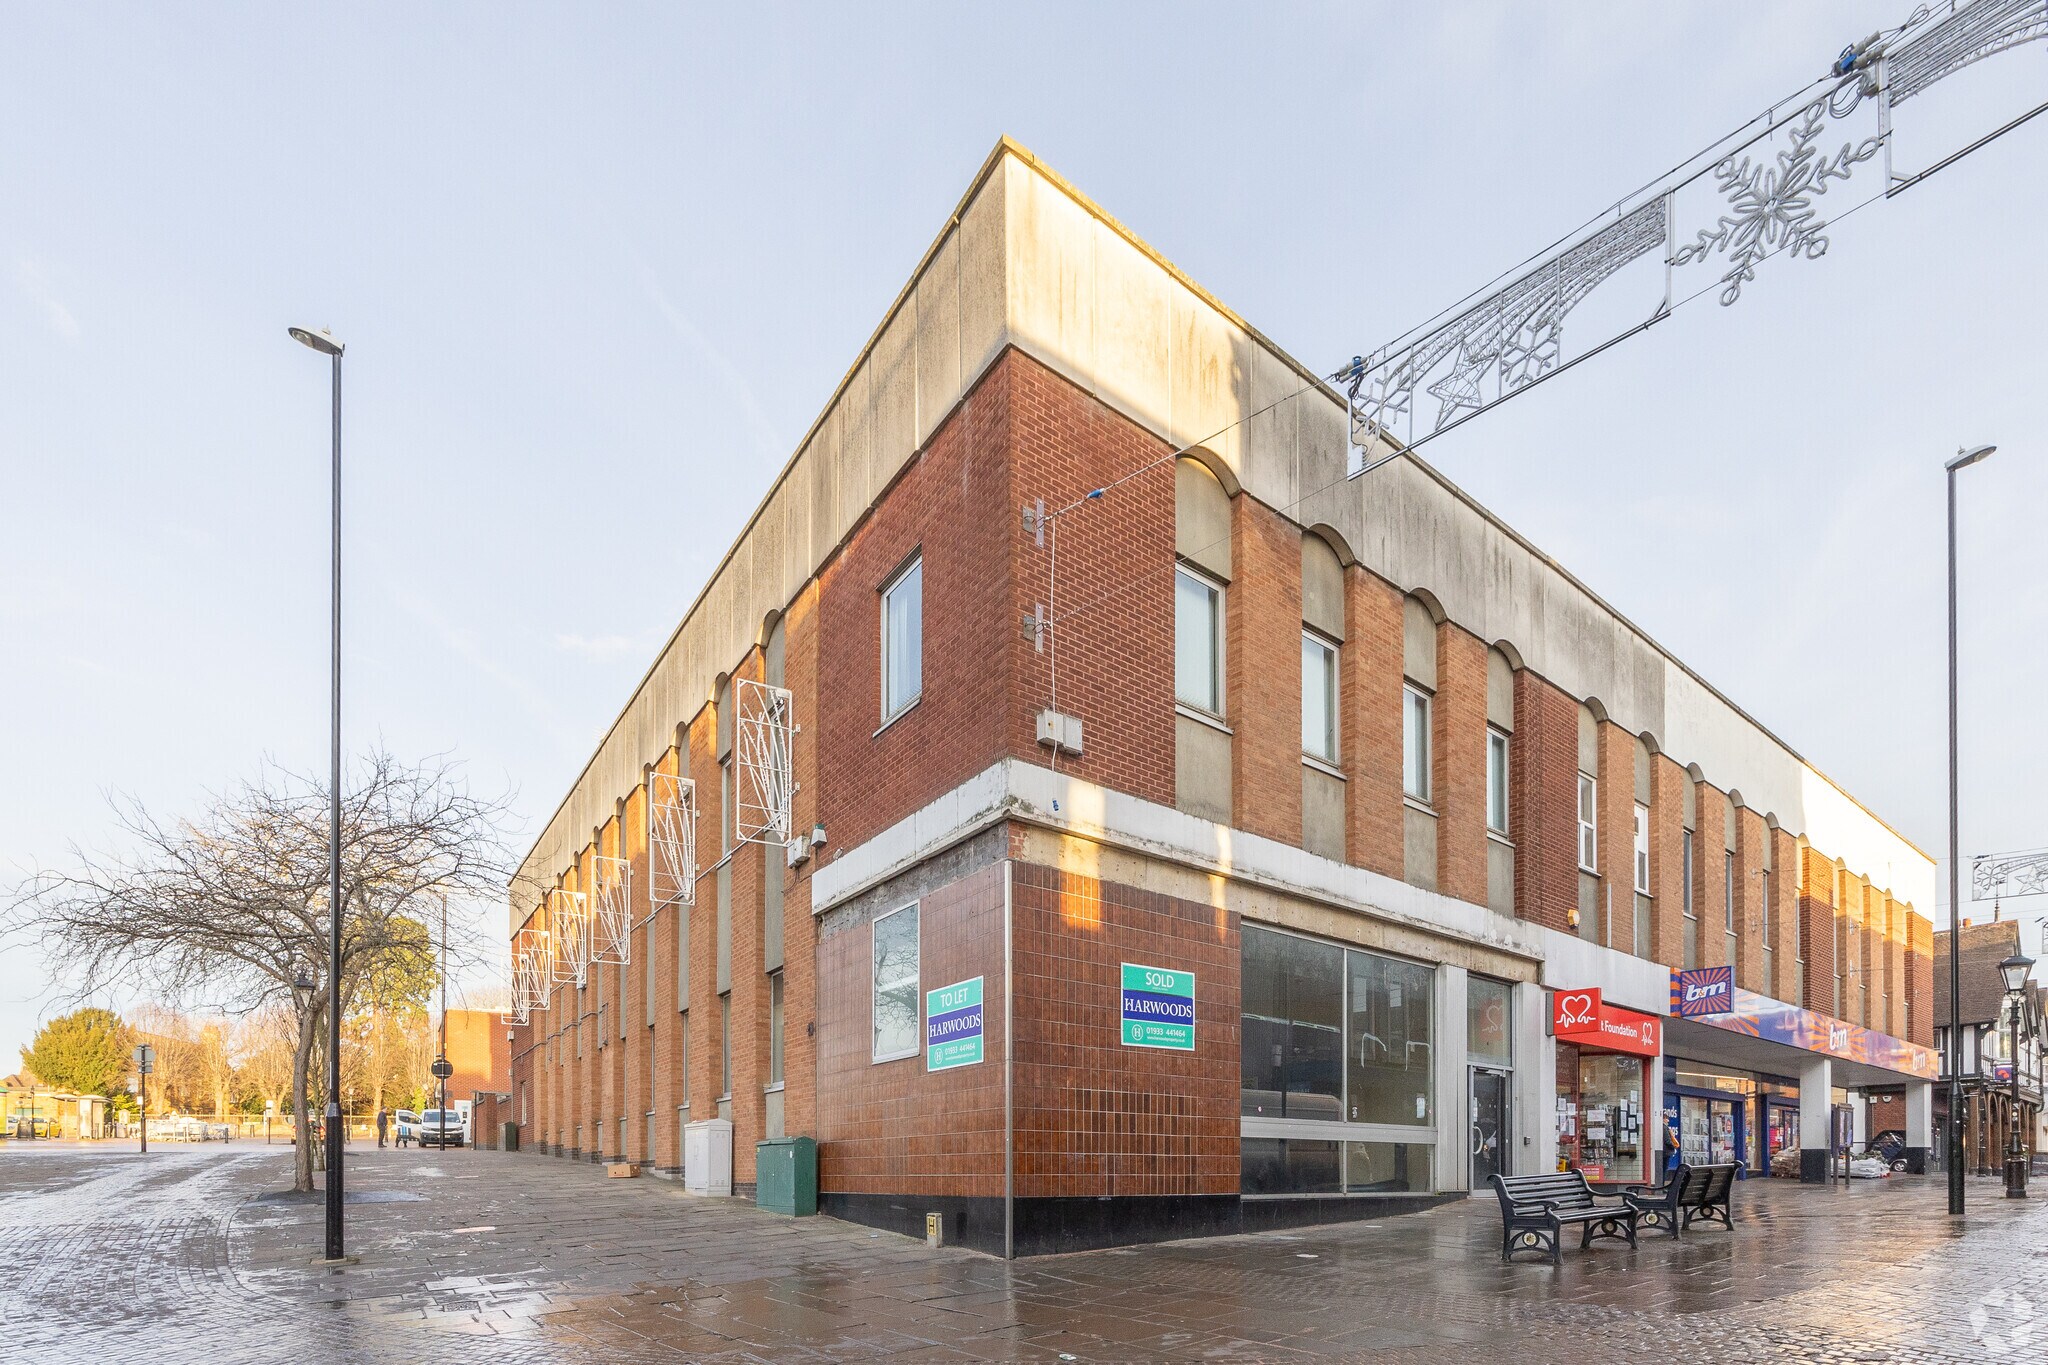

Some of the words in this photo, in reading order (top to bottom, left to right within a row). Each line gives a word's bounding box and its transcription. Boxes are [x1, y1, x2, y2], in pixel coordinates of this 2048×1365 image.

[1145, 972, 1175, 988] SOLD
[941, 993, 953, 1008] TO
[954, 988, 968, 1004] LET
[1686, 981, 1726, 1002] b&m
[1124, 998, 1192, 1018] HARWOODS
[929, 1013, 981, 1038] HARWOODS
[1146, 1026, 1163, 1036] 01933
[1165, 1028, 1186, 1038] 441464
[1605, 1021, 1638, 1038] Foundation
